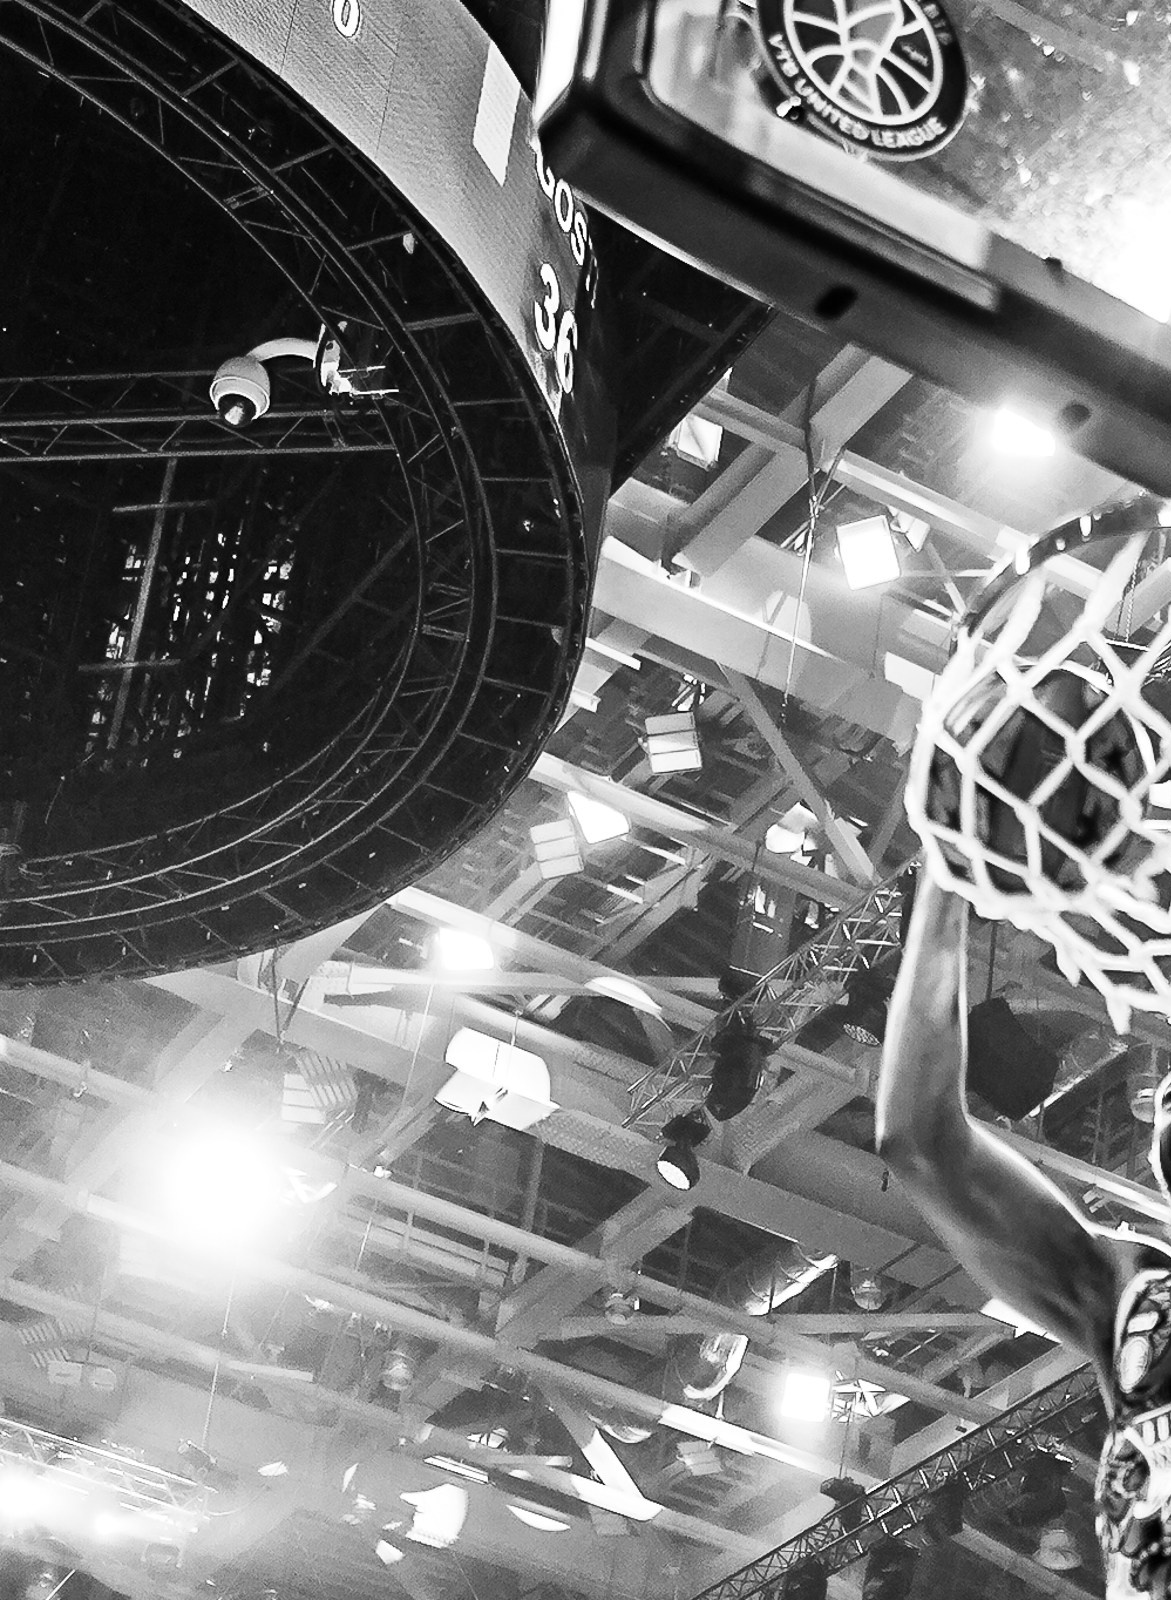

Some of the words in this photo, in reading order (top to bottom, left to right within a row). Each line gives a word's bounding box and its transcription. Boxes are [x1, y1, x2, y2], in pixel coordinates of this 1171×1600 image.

[795, 78, 870, 141] UNITED
[871, 117, 947, 148] LEAGUE
[534, 263, 578, 393] 36
